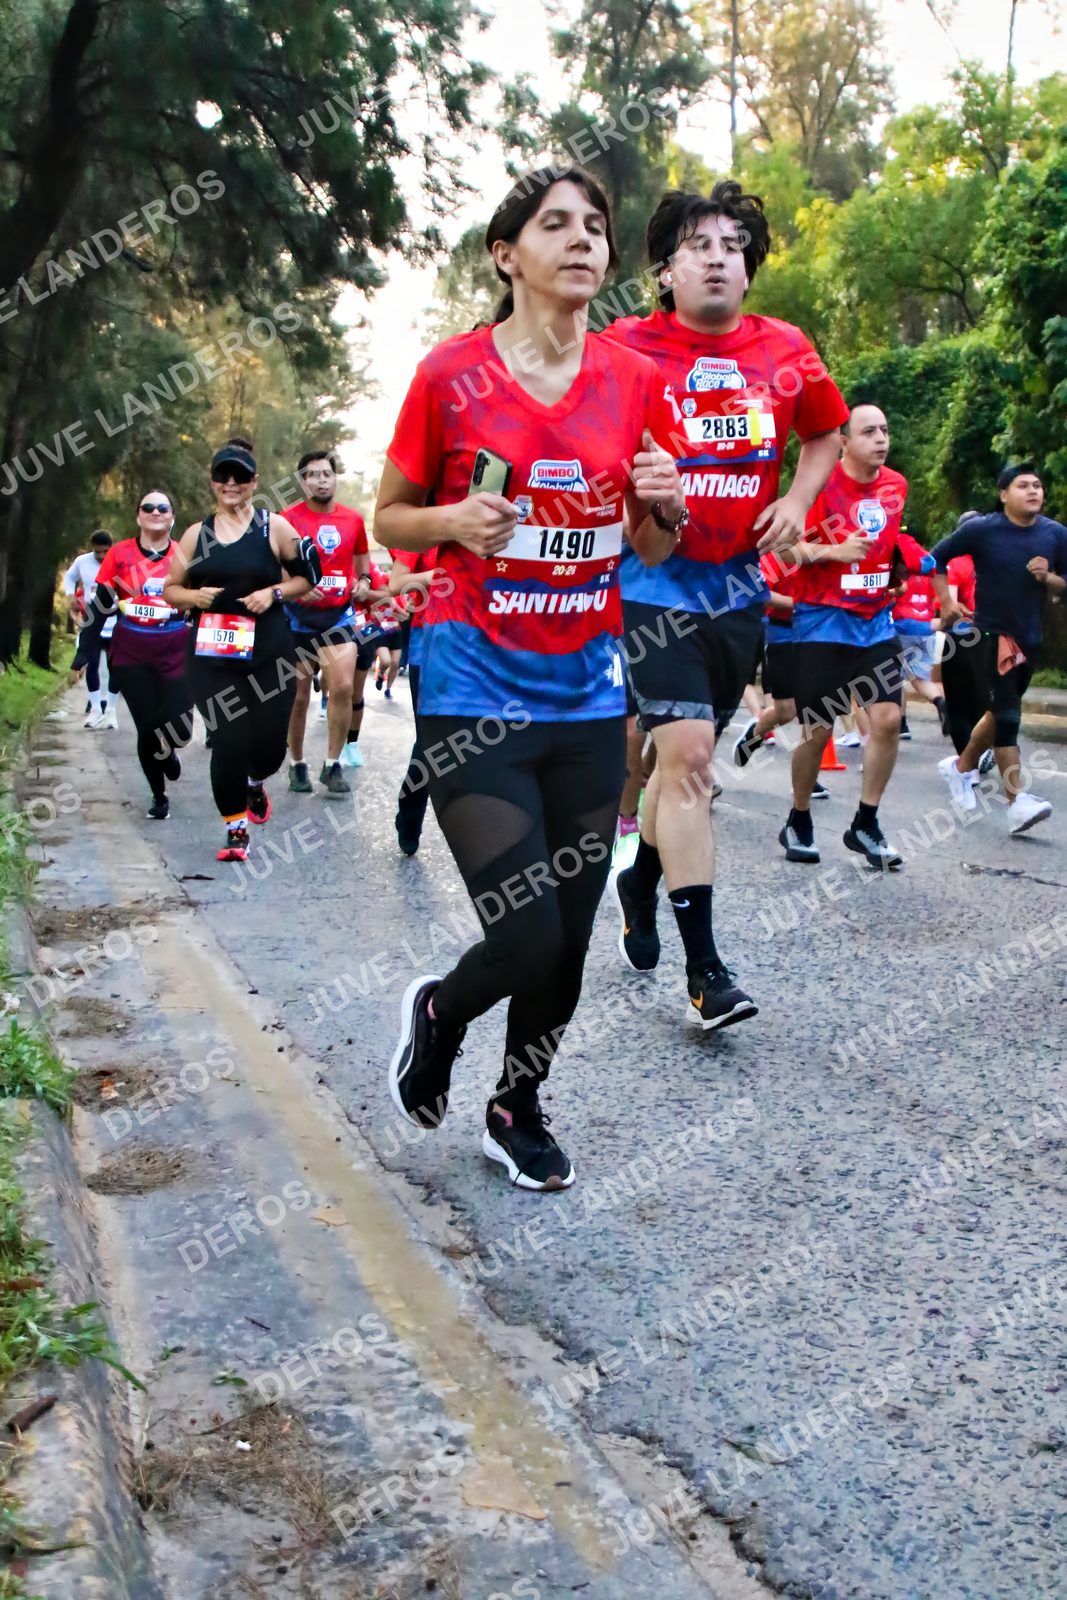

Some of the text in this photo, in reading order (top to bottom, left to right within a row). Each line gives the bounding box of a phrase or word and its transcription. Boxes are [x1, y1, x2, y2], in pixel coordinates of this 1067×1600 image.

[701, 362, 732, 370] BIMBO
[701, 372, 732, 382] Global
[696, 379, 720, 388] Race
[702, 417, 748, 439] 2883
[537, 468, 574, 478] BIMBO
[680, 472, 760, 498] ANTIAGO
[539, 529, 596, 560] 1490
[863, 574, 882, 588] 3611
[134, 605, 154, 617] 1430
[214, 630, 234, 643] 1578
